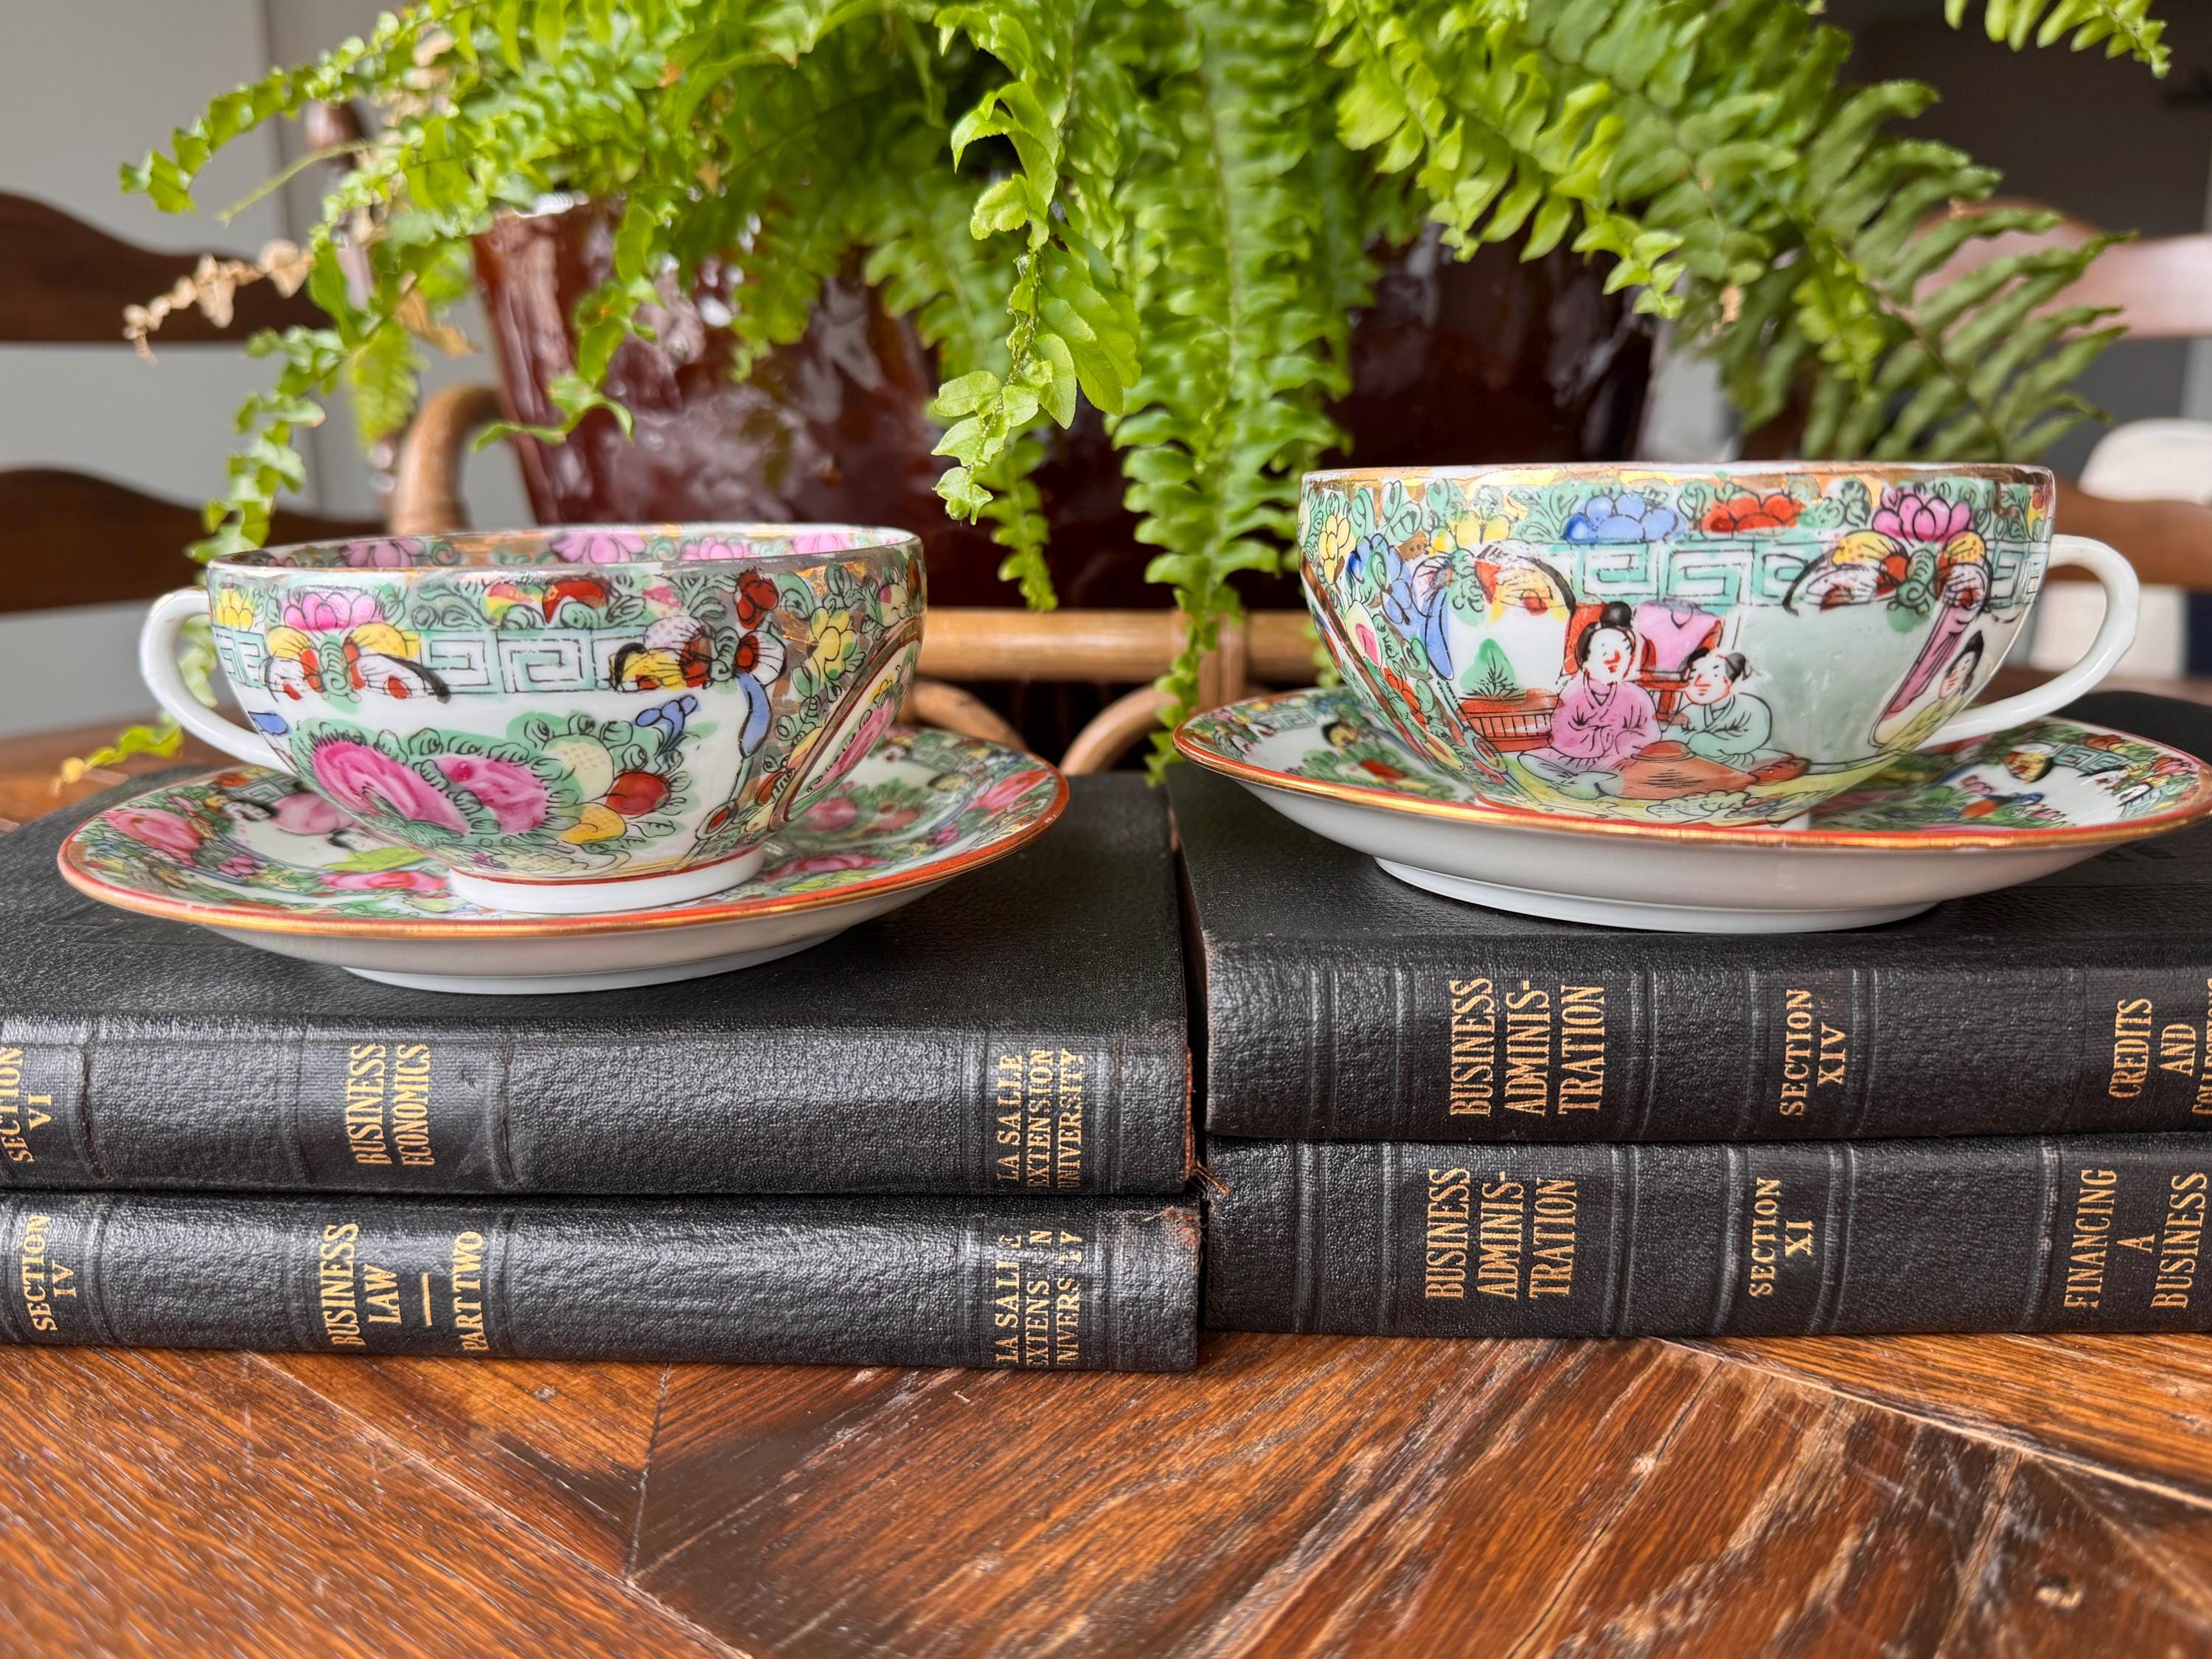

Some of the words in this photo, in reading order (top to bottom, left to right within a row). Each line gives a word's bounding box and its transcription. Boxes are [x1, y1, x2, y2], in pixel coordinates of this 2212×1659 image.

[344, 1043, 392, 1165] BUSINESS
[391, 1043, 435, 1166] ECONOMICS
[998, 1054, 1023, 1145] SALLE
[1449, 978, 1495, 1116] BUSINESS
[1503, 979, 1550, 1116] ADMINIS-
[1557, 985, 1605, 1115] TRATION
[1779, 989, 1814, 1116] SECTION
[1816, 1023, 1846, 1088] XIV
[2108, 998, 2152, 1099] CREDITS
[2160, 1023, 2196, 1077] AND
[27, 1093, 52, 1131] VI
[998, 1151, 1020, 1181] LA
[1027, 1049, 1054, 1189] EXTENSION
[1057, 1048, 1085, 1189] UNIVERSITY
[21, 1212, 58, 1331] SECTION
[52, 1259, 77, 1297] IV
[320, 1222, 366, 1346] BUSINESS
[364, 1263, 402, 1325] LAW
[451, 1231, 484, 1293] TWO
[1425, 1168, 1471, 1300] BUSINESS
[1477, 1171, 1525, 1301] ADMINIS-
[1528, 1176, 1578, 1298] TRATION
[1749, 1177, 1782, 1298] SECTION
[1784, 1219, 1814, 1256] XI
[2064, 1169, 2118, 1309] FINANCING
[2117, 1233, 2155, 1253] A
[2151, 1172, 2208, 1309] BUSINESS
[453, 1296, 490, 1351] PART
[995, 1335, 1020, 1363] LA
